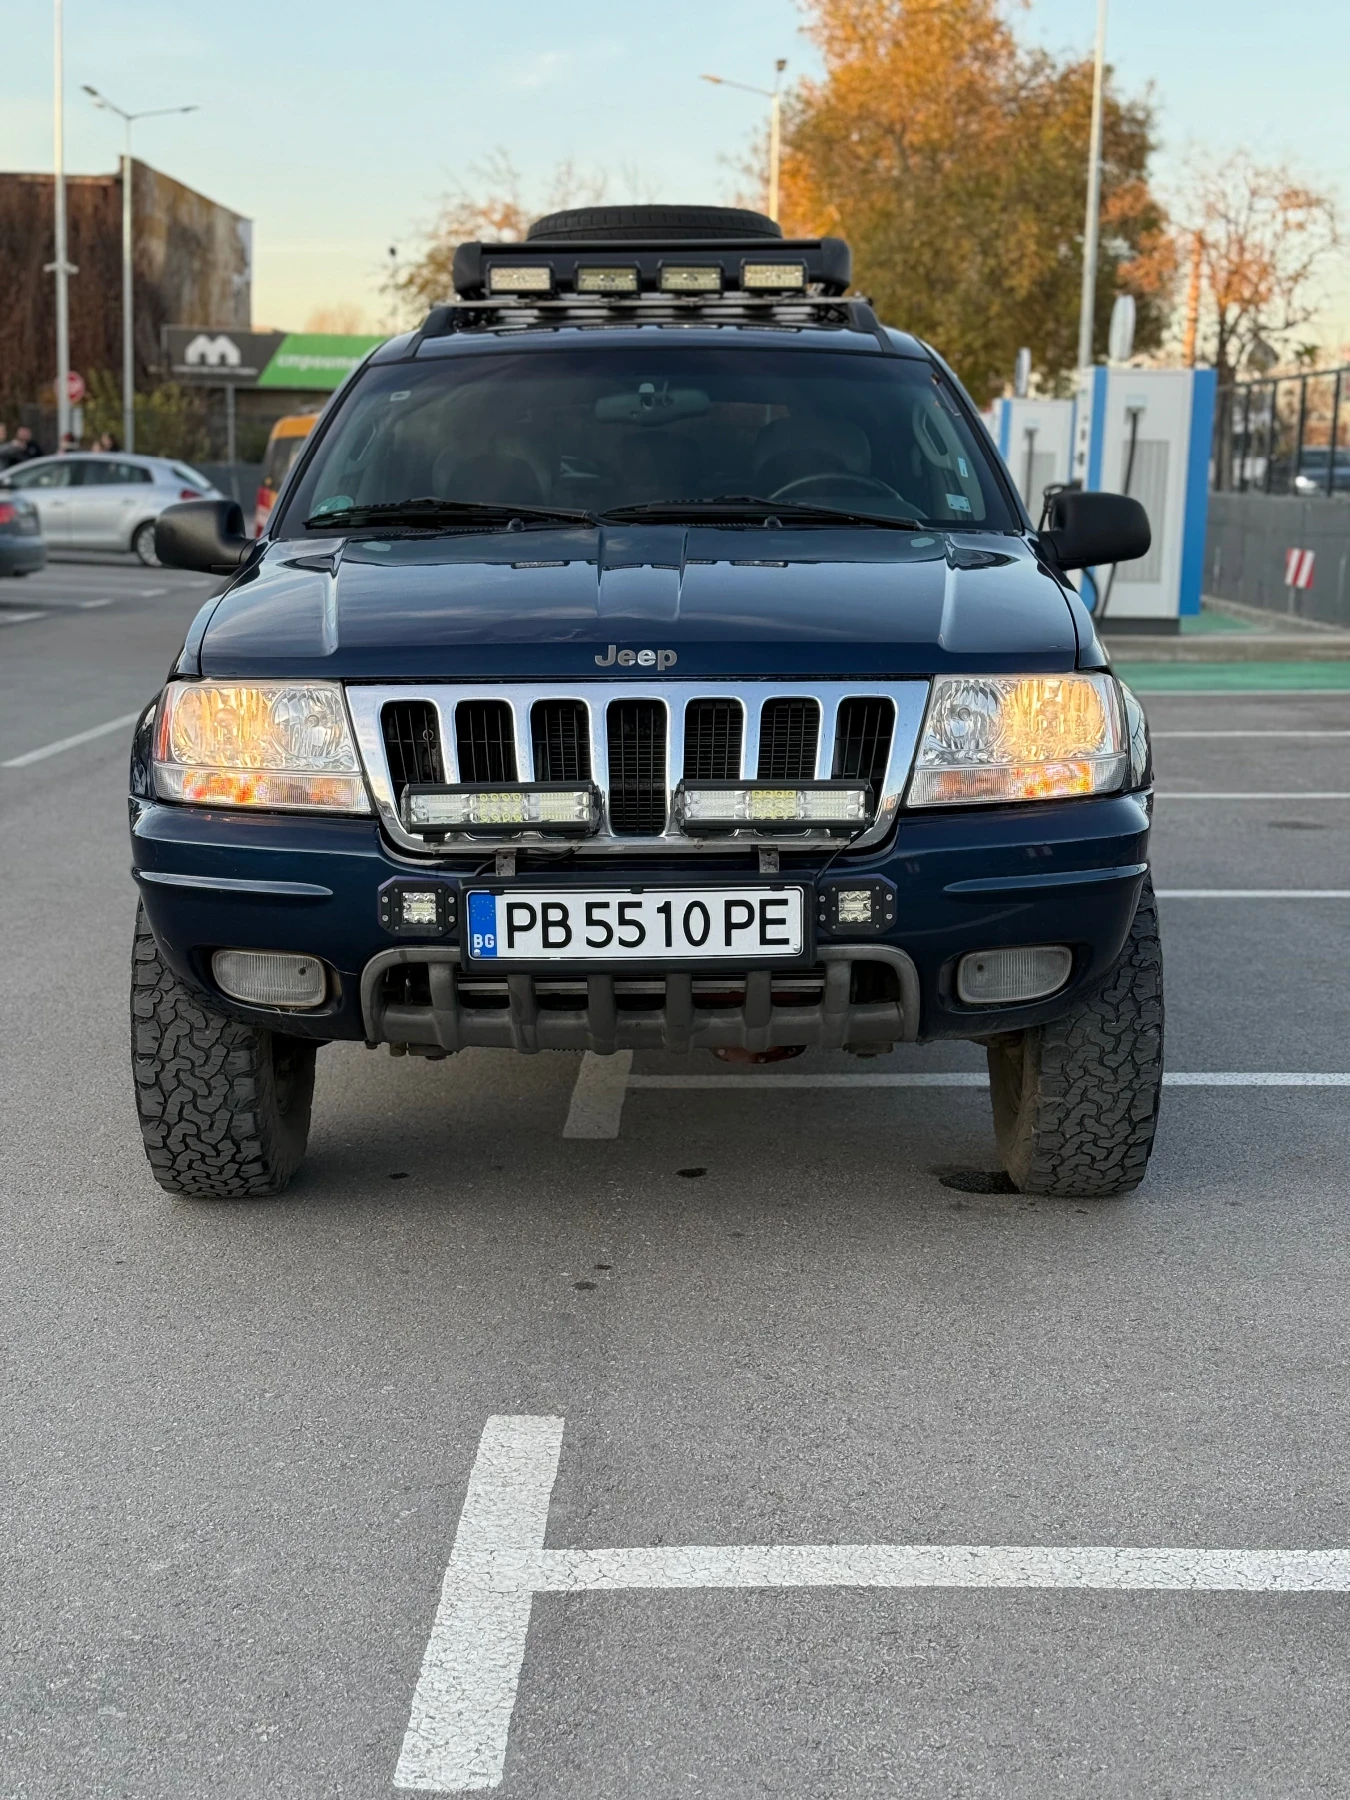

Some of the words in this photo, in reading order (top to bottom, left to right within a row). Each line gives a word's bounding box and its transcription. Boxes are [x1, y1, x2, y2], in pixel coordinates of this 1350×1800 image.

[594, 644, 678, 671] Jeep
[505, 901, 573, 949] PB
[585, 900, 711, 948] 5510
[723, 898, 790, 947] PE
[472, 933, 495, 949] BG
